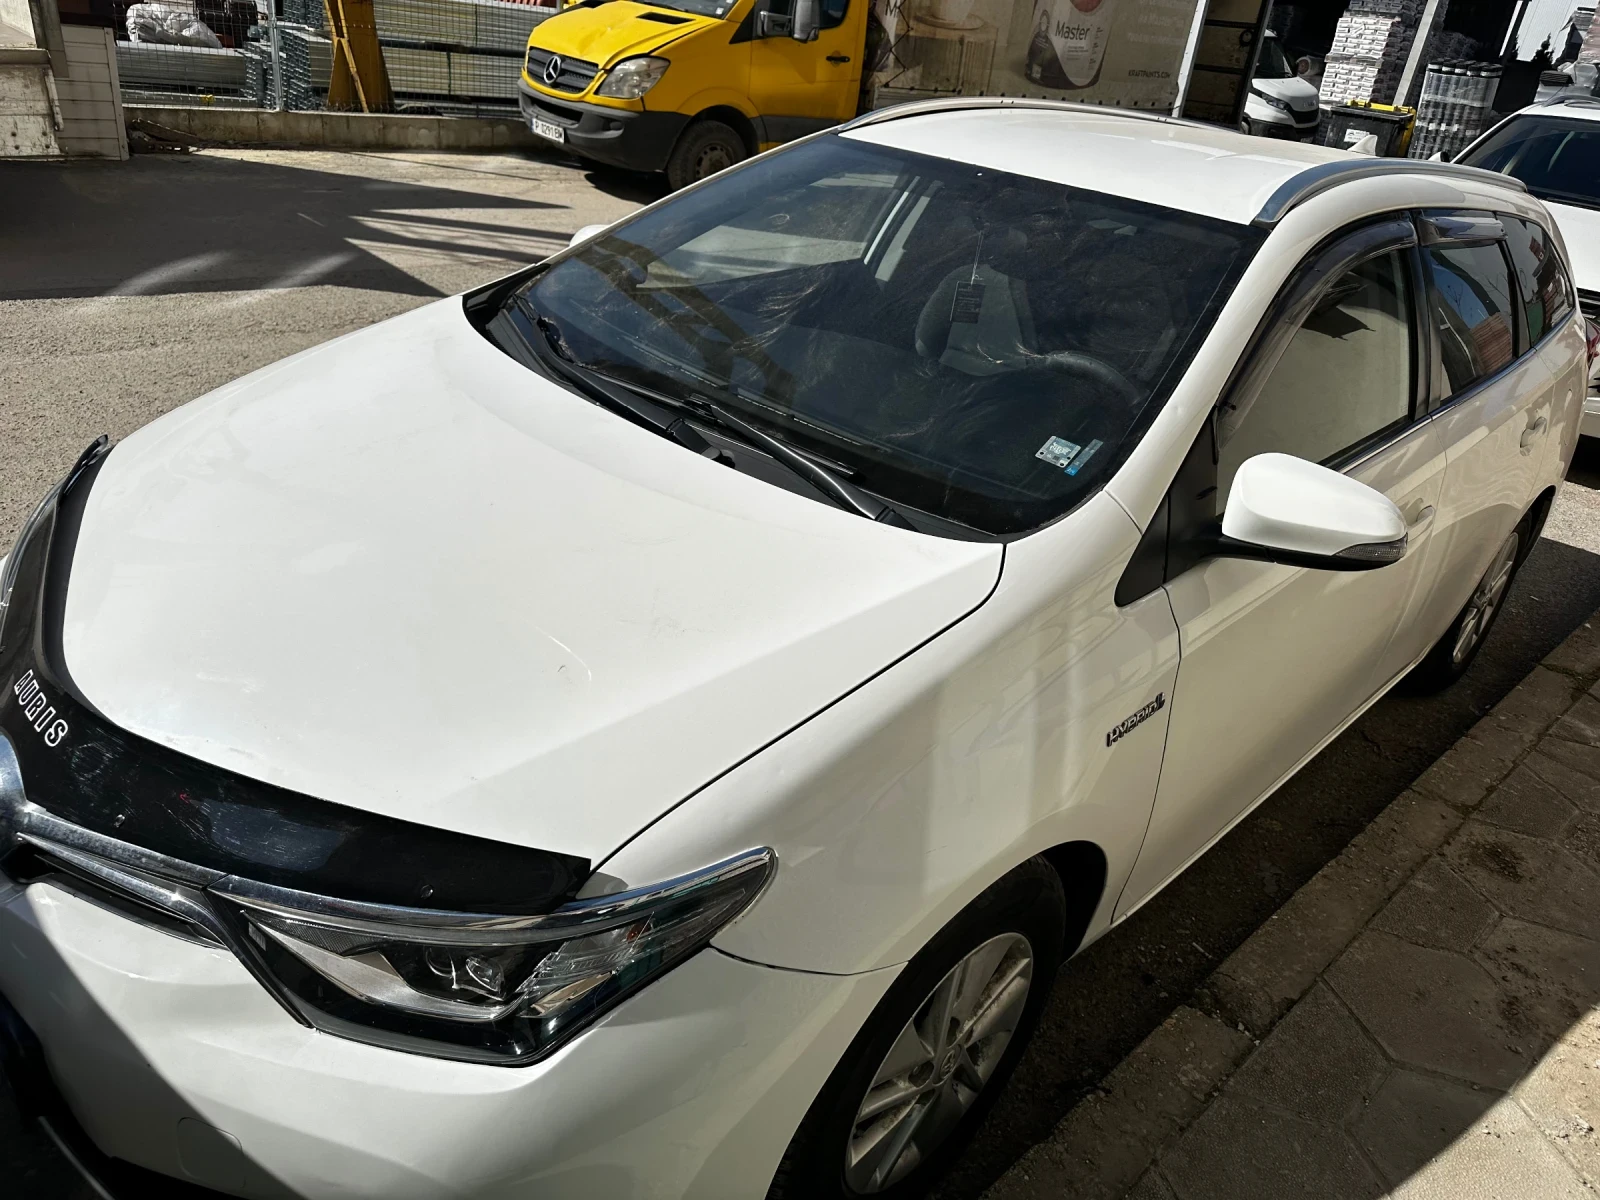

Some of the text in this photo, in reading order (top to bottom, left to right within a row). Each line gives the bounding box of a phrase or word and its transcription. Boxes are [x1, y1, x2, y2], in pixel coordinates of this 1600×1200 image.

[1055, 20, 1091, 40] Master
[14, 669, 69, 747] AURIS
[1106, 692, 1166, 747] HYBRID
